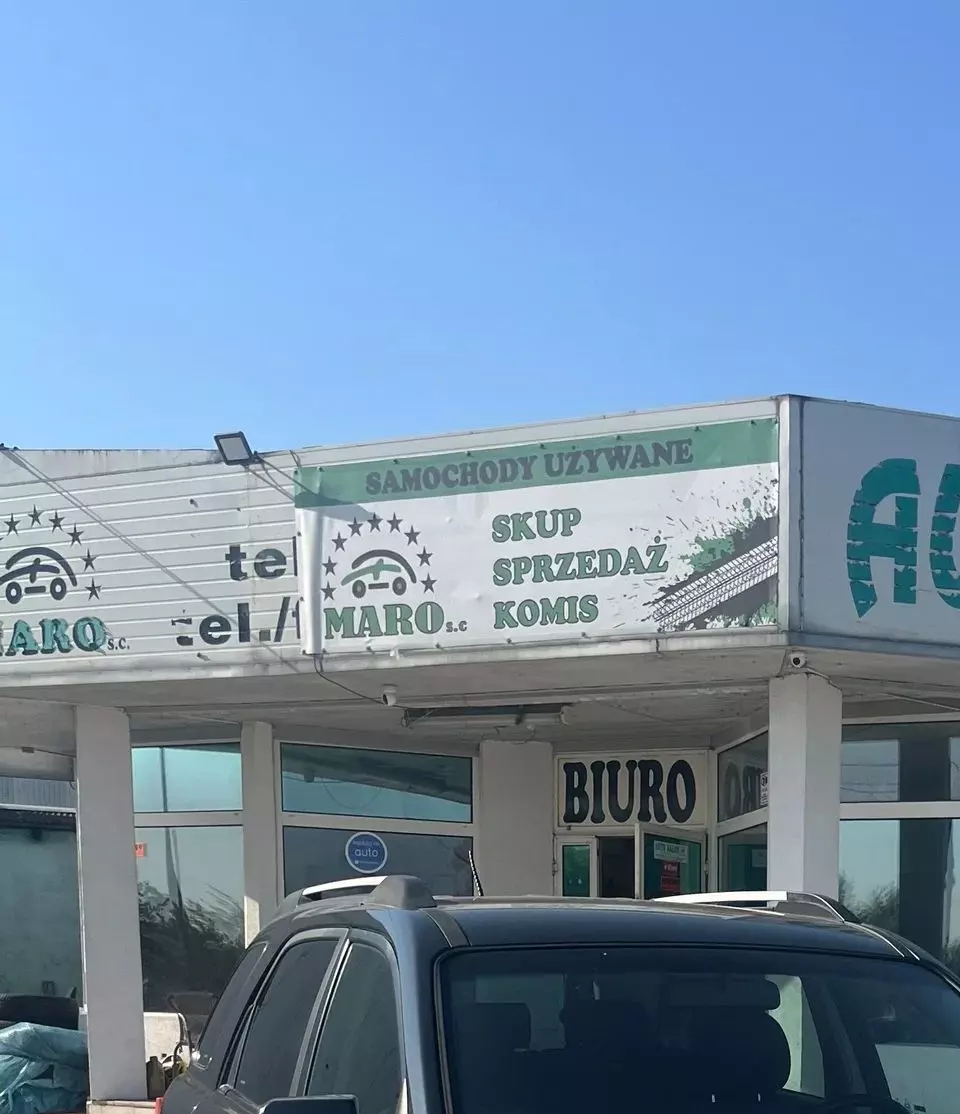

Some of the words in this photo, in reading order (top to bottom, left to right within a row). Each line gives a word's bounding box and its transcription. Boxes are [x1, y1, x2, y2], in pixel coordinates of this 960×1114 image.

[366, 455, 537, 495] SAMOCHODY
[492, 507, 582, 543] SKUP
[493, 535, 669, 586] SPRZEDAŻ
[323, 601, 444, 639] MARO
[493, 595, 599, 629] KOMIS
[0, 616, 107, 657] ARO
[563, 759, 697, 823] BIURO
